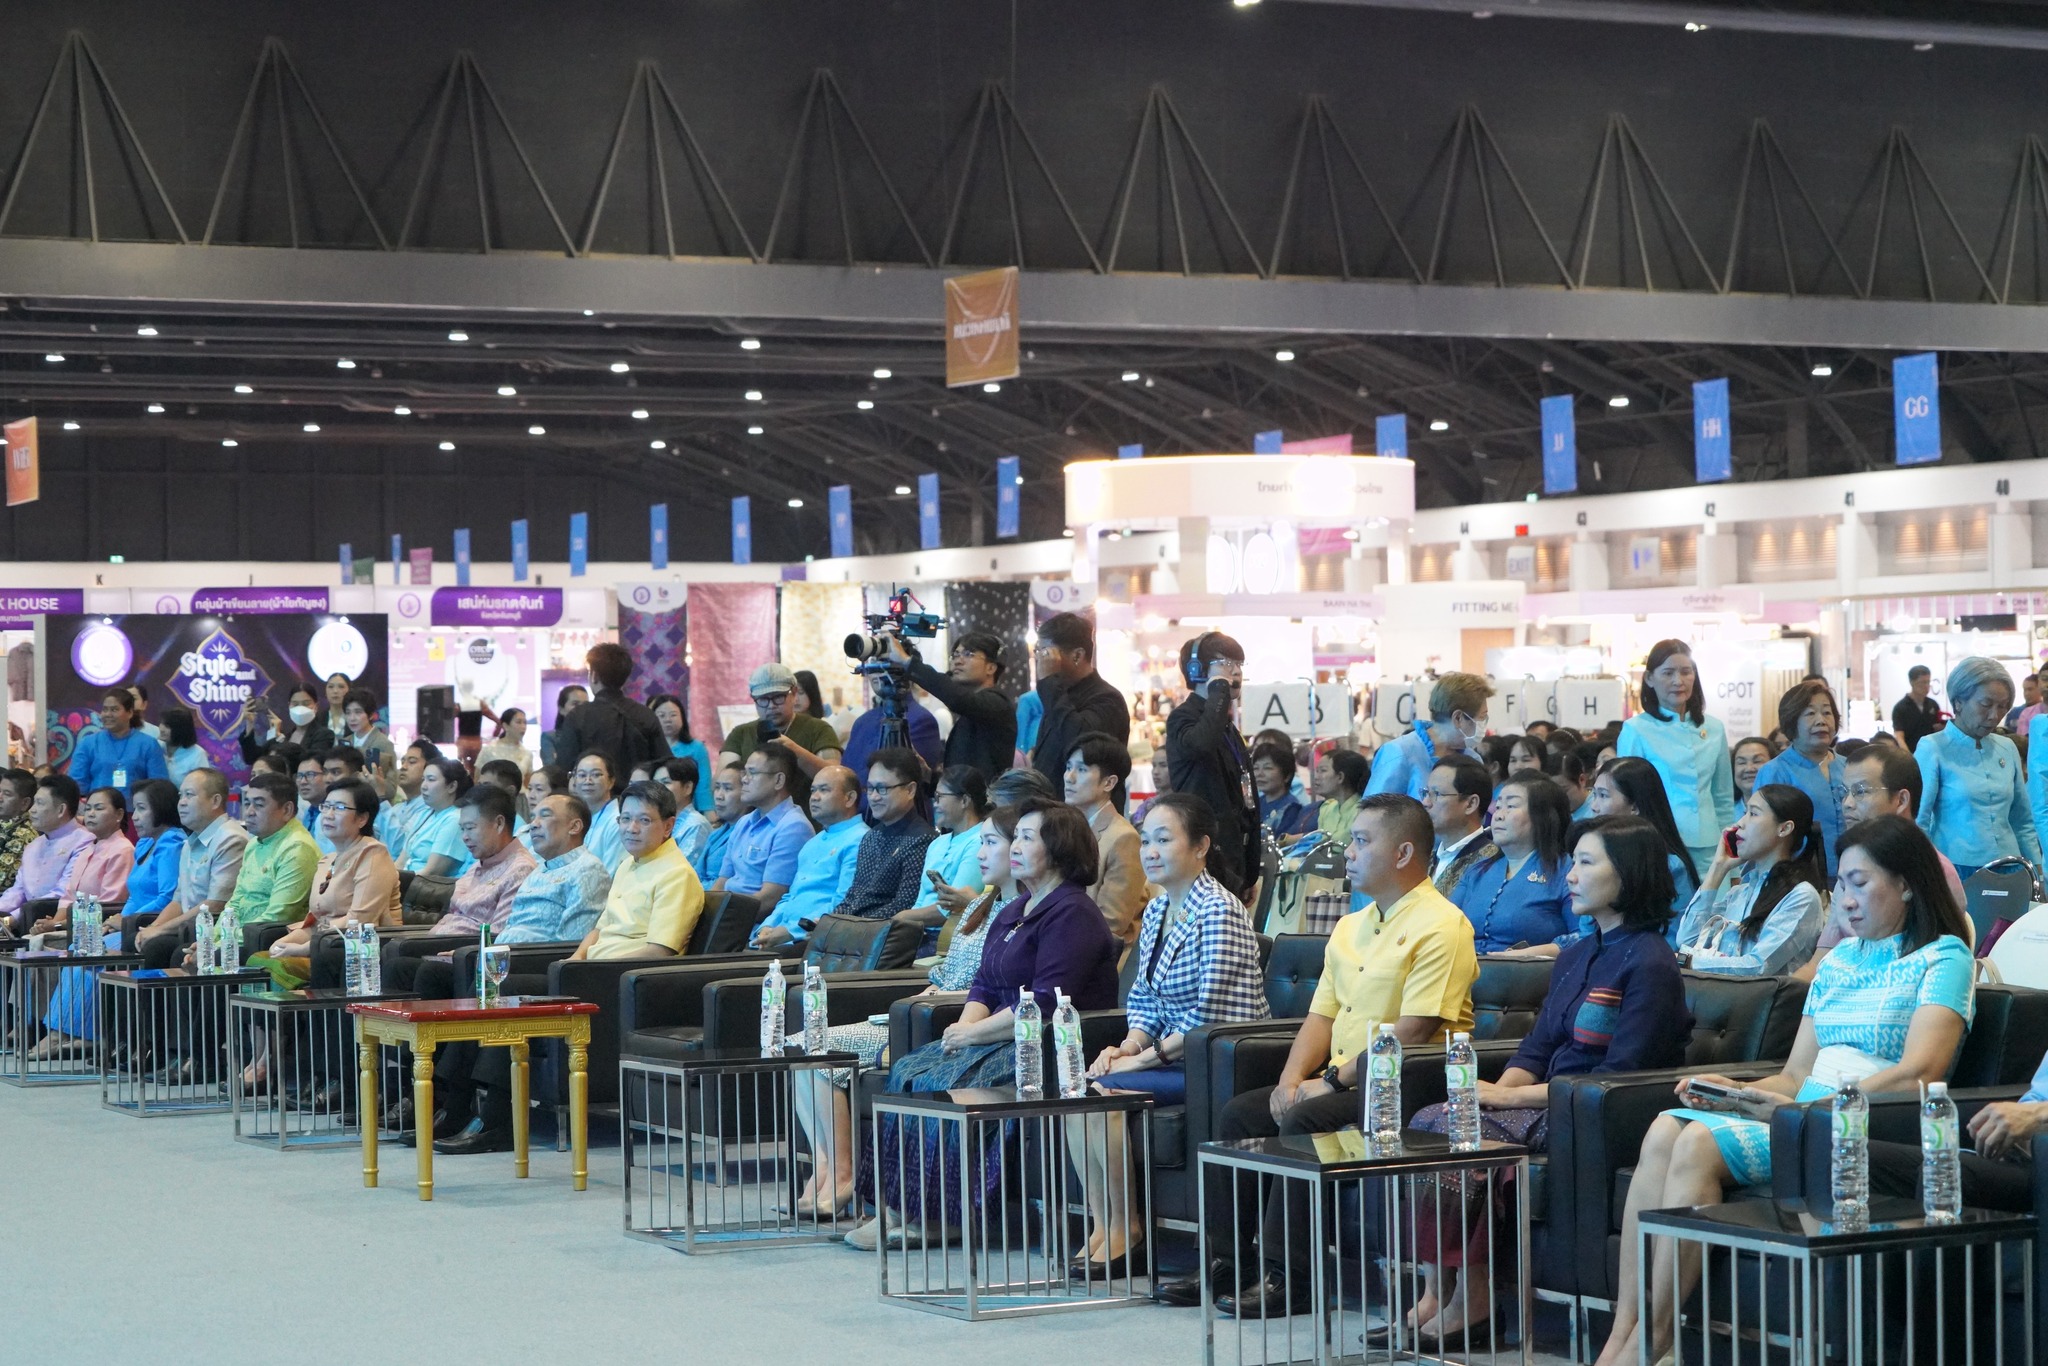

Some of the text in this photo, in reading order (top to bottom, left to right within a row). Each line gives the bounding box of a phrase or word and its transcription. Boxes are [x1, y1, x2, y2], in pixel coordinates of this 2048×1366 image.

[1702, 418, 1721, 438] HH
[96, 574, 103, 586] K
[7, 598, 60, 611] HOUSE
[1452, 602, 1498, 613] FITTING
[180, 652, 256, 682] Style and
[188, 677, 252, 702] Shine
[1717, 682, 1755, 698] CPOT
[1261, 693, 1290, 725] A
[1396, 692, 1417, 725] C
[1505, 694, 1516, 714] F
[1583, 696, 1597, 716] H
